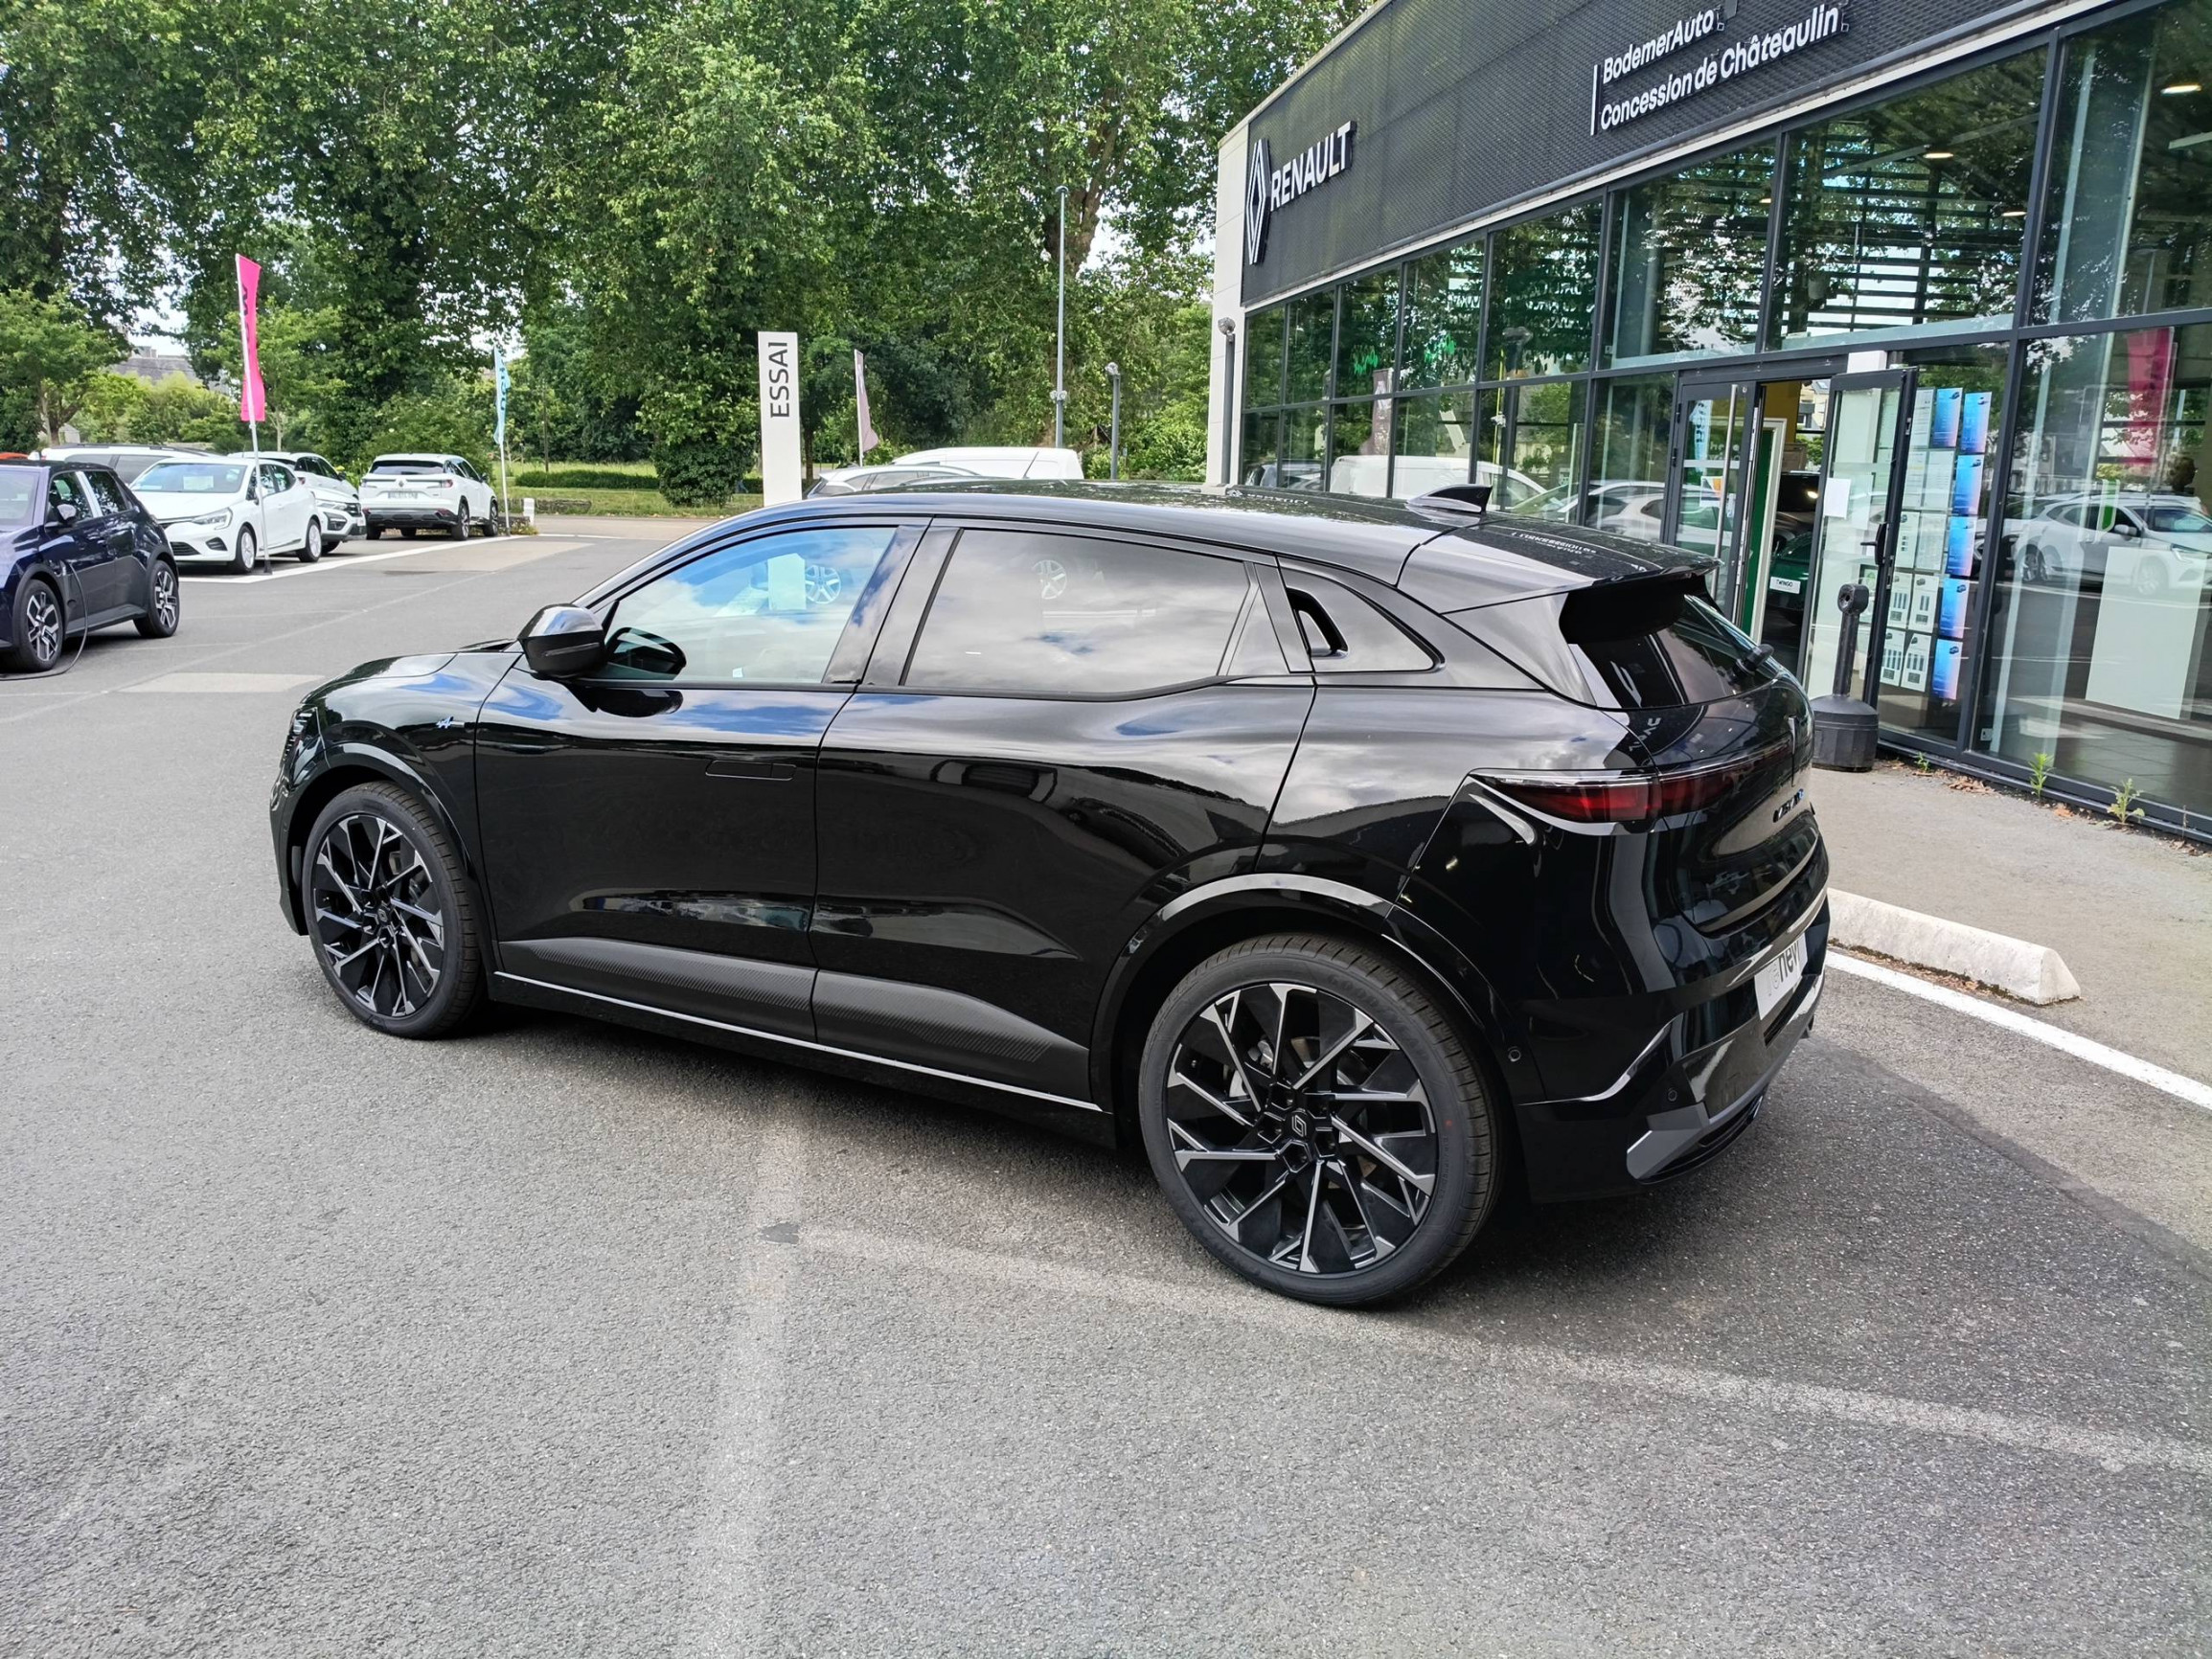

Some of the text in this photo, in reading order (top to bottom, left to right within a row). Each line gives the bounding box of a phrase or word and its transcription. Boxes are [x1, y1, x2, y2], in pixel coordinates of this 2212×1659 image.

[1601, 4, 1839, 130] Concession de Châteaulin
[1603, 8, 1714, 84] BodemerAuto
[1270, 120, 1352, 213] RENAULT
[768, 342, 789, 418] ESSAI
